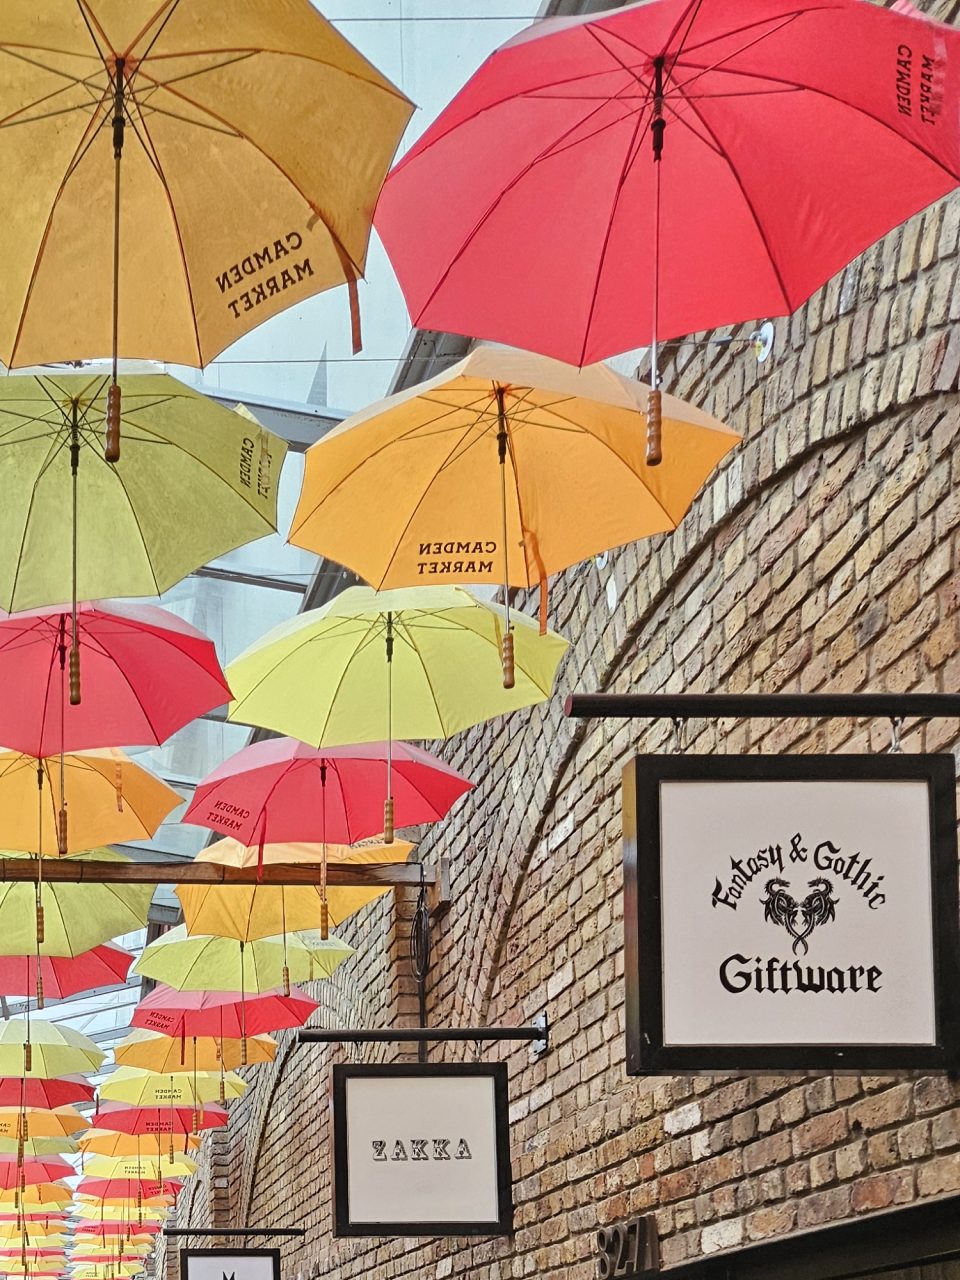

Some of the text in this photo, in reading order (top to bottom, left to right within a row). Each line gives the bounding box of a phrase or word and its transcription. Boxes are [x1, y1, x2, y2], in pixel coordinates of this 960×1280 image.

[711, 832, 887, 911] Fantasy & Gothic
[719, 953, 883, 995] Giftware
[372, 1138, 472, 1162] ZAKKA
